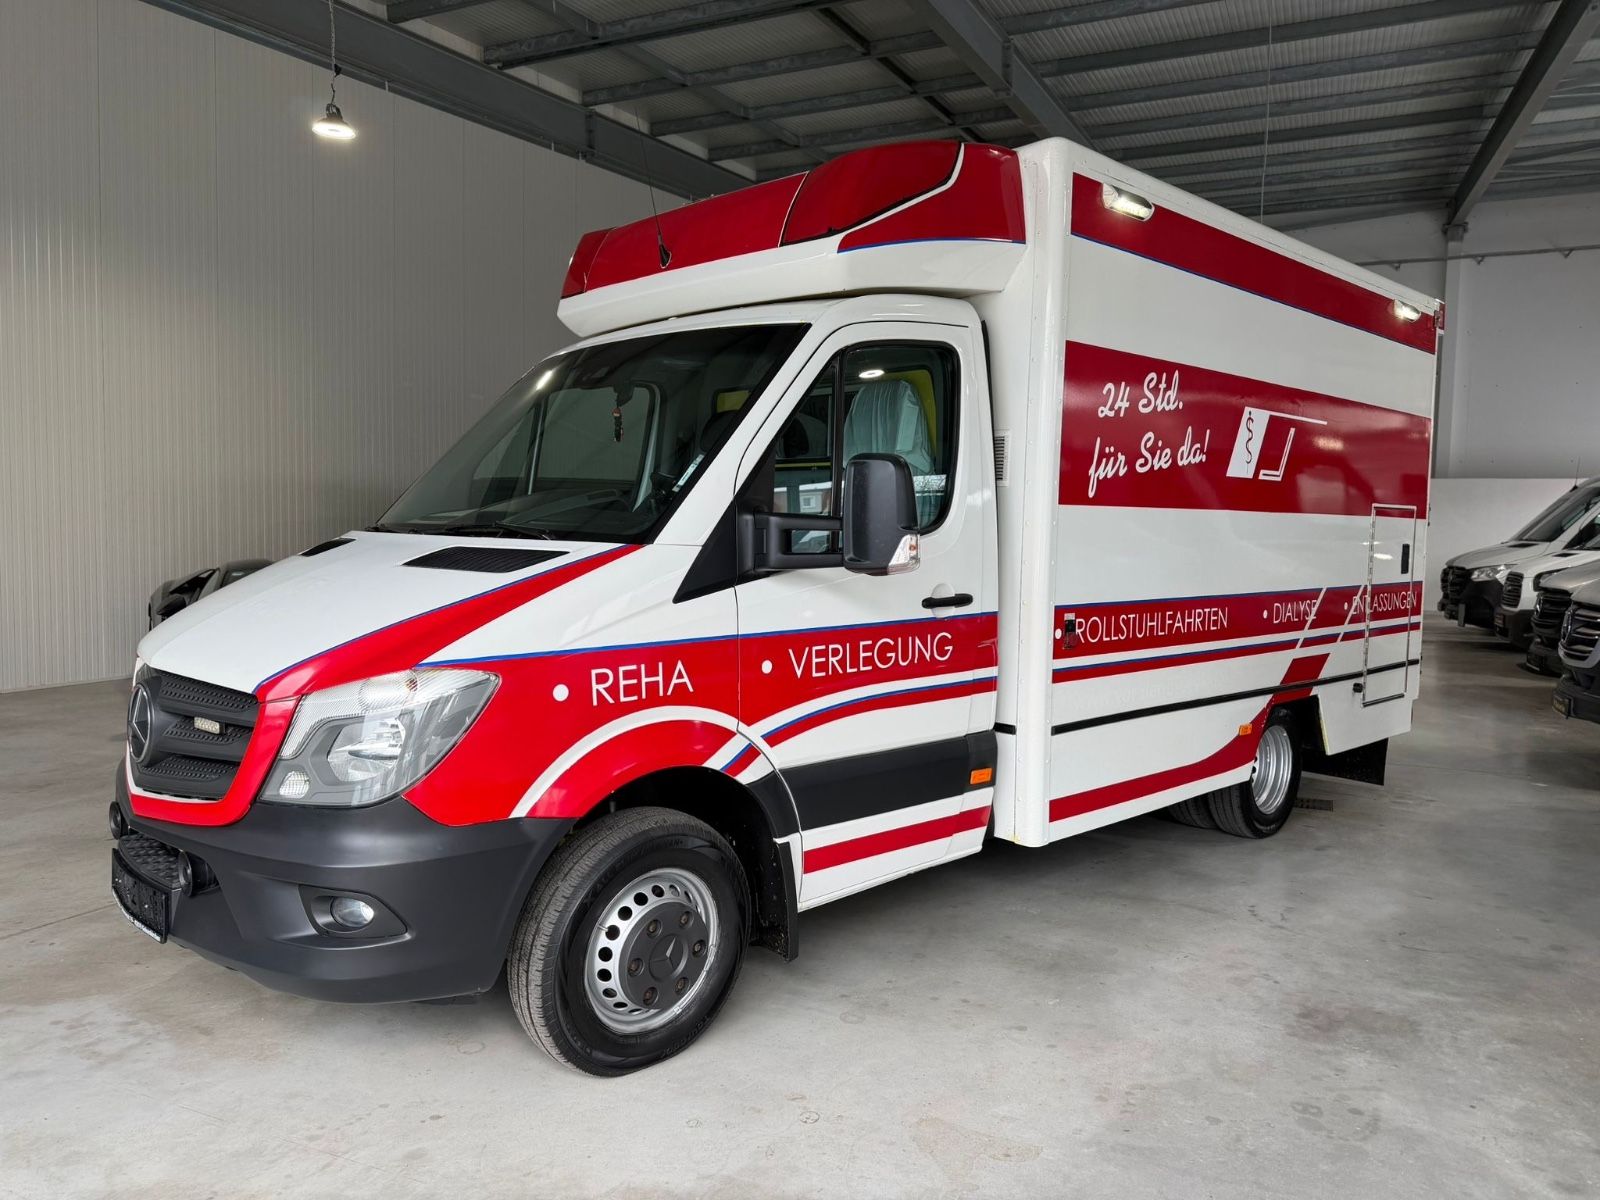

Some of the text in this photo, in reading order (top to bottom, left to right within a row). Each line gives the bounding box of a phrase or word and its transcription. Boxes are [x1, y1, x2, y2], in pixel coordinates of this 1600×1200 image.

[1098, 370, 1183, 418] 24 Std.
[1088, 426, 1210, 498] für Sie da!
[1075, 607, 1228, 643] ROLLSTUHLFAHRTEN
[1273, 599, 1317, 624] DIALYSE
[590, 632, 954, 707] REHA VERLEGUNG
